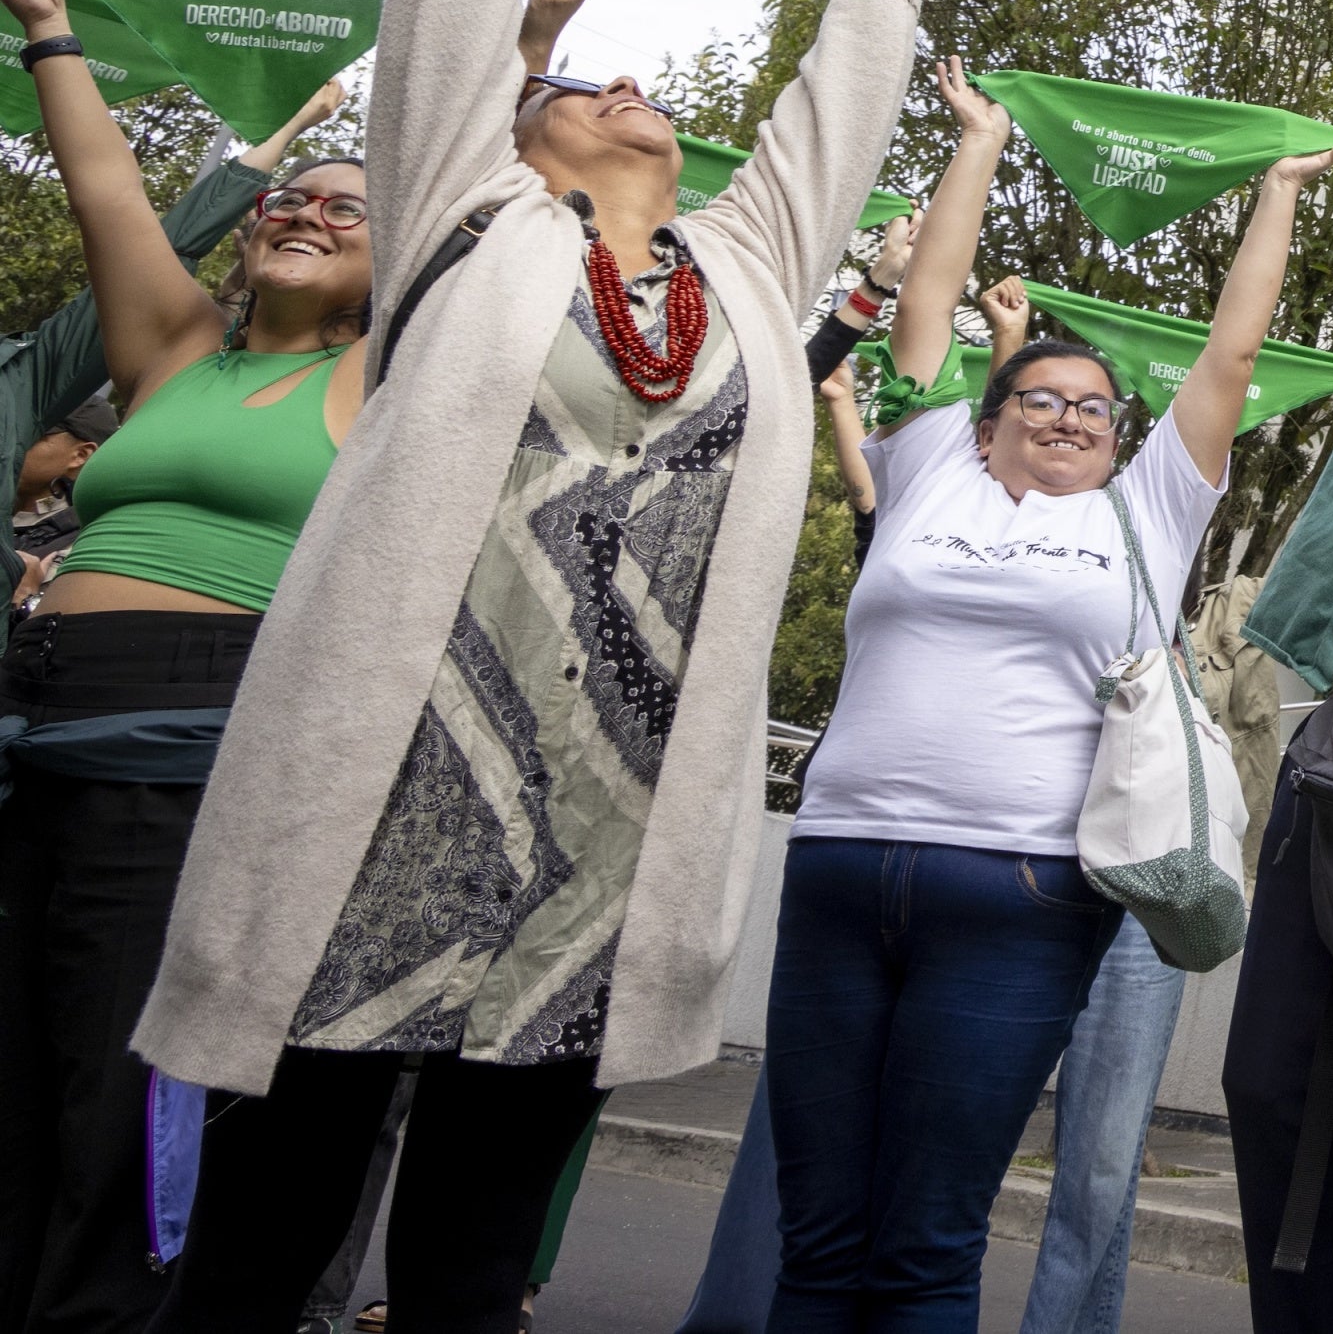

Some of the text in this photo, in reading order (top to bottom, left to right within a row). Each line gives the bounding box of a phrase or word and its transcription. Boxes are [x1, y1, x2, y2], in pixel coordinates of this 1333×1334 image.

[186, 4, 352, 39] DERECHO al ABORTO
[220, 32, 312, 52] #JustaLibertad
[1072, 119, 1092, 134] Que
[1094, 127, 1104, 137] el
[1107, 130, 1138, 146] aborto
[1141, 140, 1153, 149] no
[1187, 147, 1216, 163] delito
[1107, 145, 1157, 171] JUSTA
[1092, 164, 1167, 195] LIBERTAD
[1149, 361, 1190, 382] DEREC
